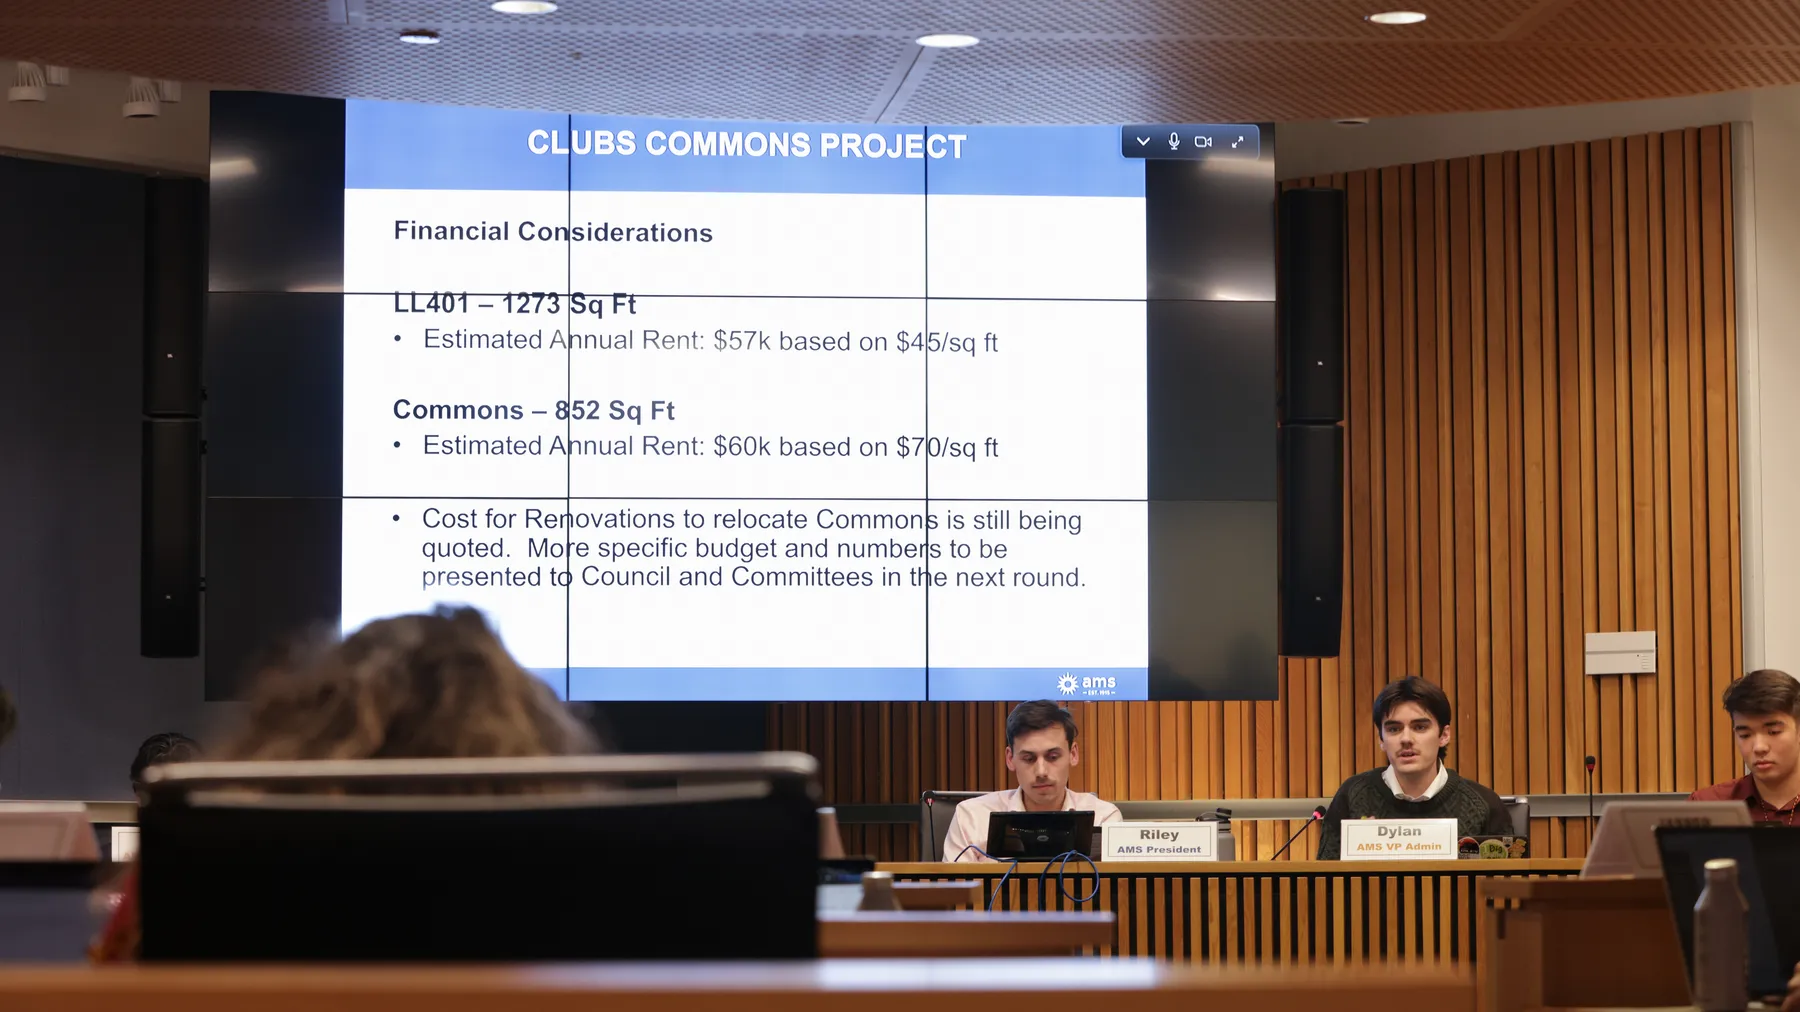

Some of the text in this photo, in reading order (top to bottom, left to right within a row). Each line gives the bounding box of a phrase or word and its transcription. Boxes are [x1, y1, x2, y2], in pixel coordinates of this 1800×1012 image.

[527, 129, 968, 159] CLUBS COMMONS PROJECT
[394, 219, 713, 243] Financial Considerations
[394, 291, 468, 314] LL401
[502, 291, 561, 315] 1273
[570, 292, 603, 320] Sq
[612, 293, 637, 315] Ft
[424, 328, 999, 358] Estimated Annual Rent: $57k based on $45/sq ft
[393, 399, 524, 421] Commons
[554, 400, 600, 421] 852
[608, 400, 642, 426] Sq
[651, 400, 676, 421] Ft
[424, 434, 999, 463] Estimated Annual Rent: $60k based on $70/sq ft
[422, 507, 1082, 536] Cost for Renovations to relocate Commons is still being
[422, 537, 1008, 564] quoted. More specific budget and numbers to be
[422, 565, 1086, 591] presented to Council and Committees in the next round.
[1081, 676, 1116, 688] ams
[1140, 829, 1179, 842] Riley
[1377, 825, 1422, 839] Dylan
[1117, 846, 1202, 854] AMS President
[1356, 842, 1442, 851] AMS VP Admin
